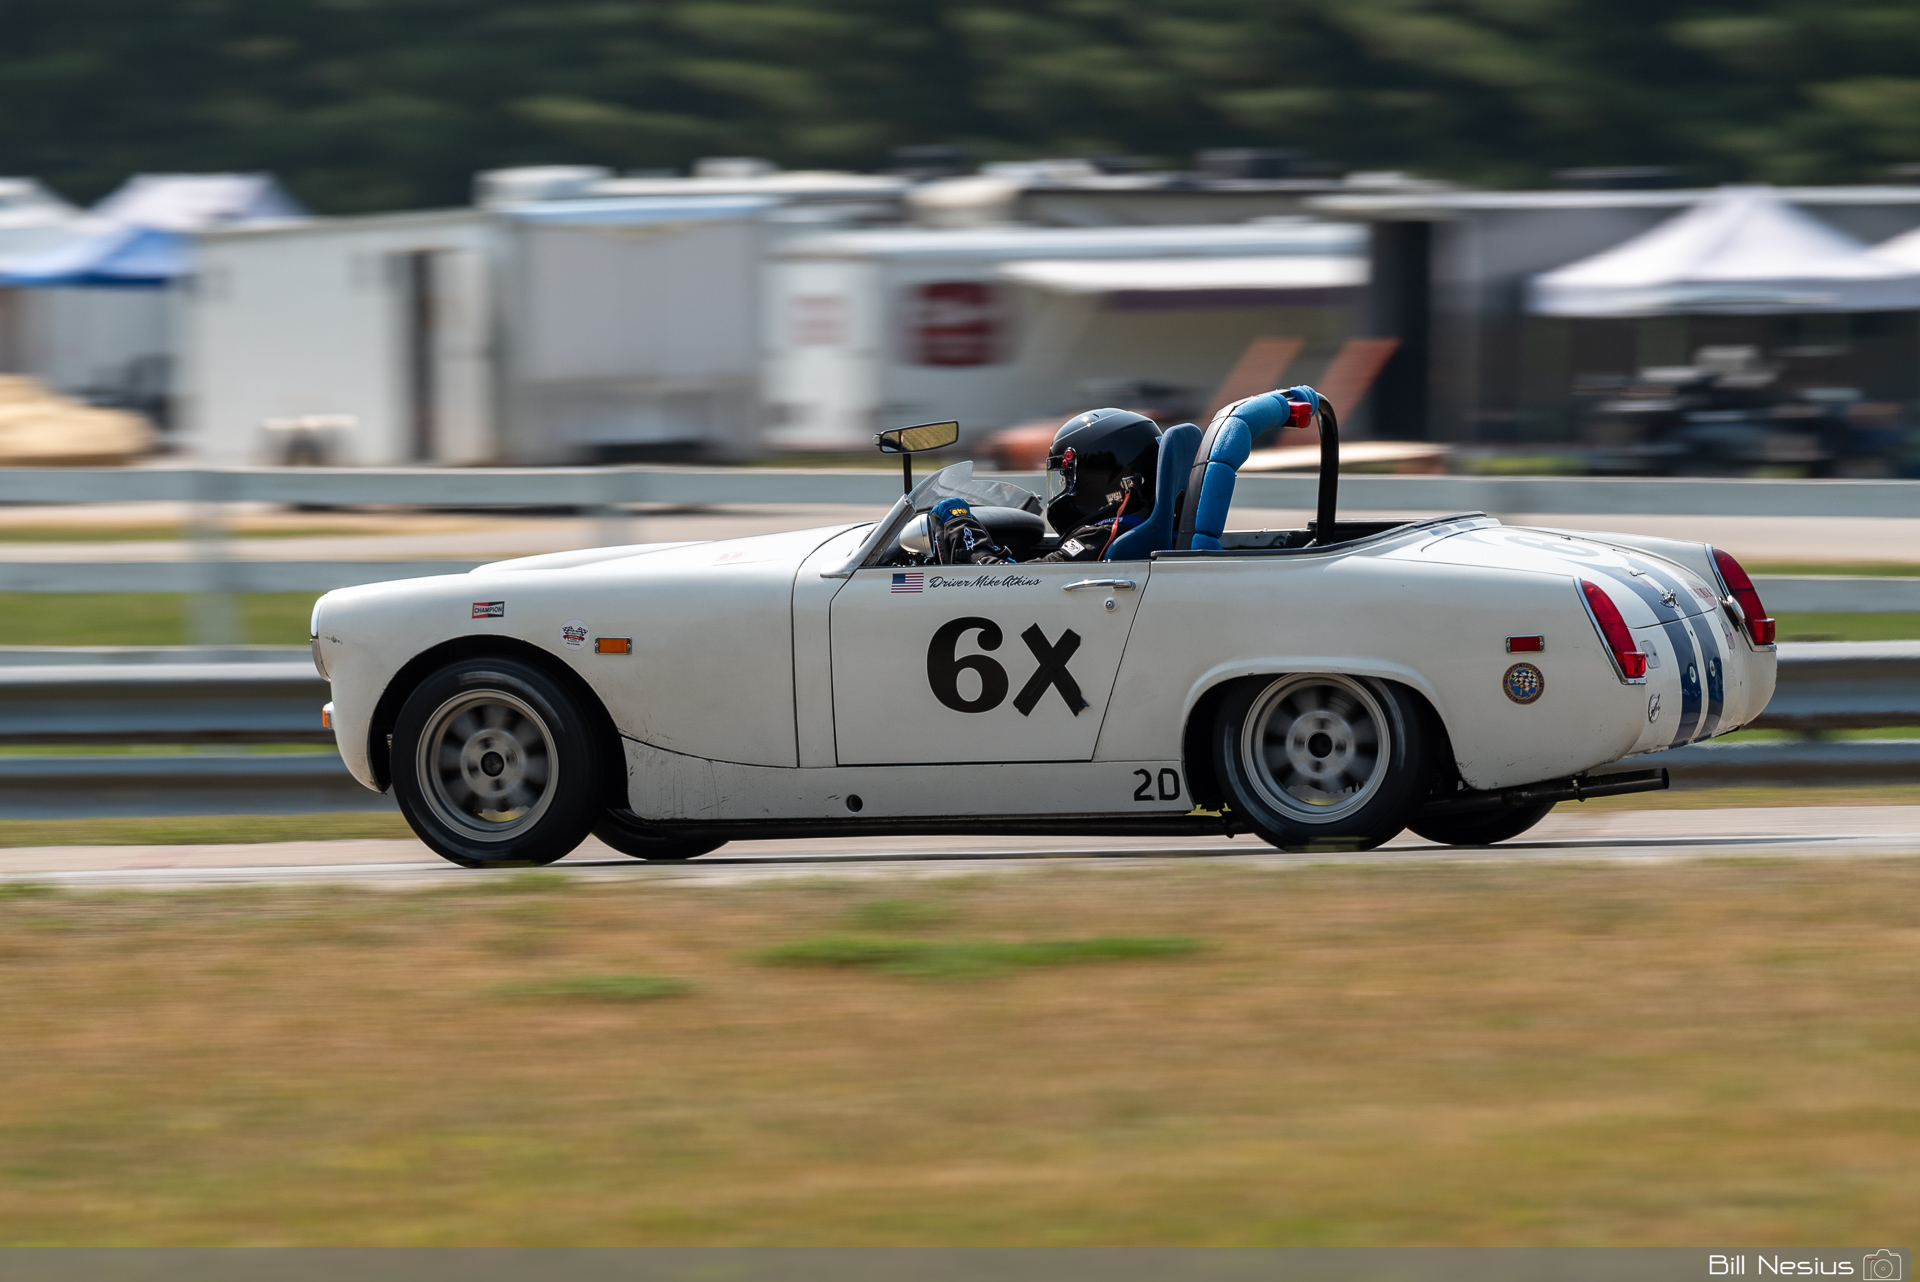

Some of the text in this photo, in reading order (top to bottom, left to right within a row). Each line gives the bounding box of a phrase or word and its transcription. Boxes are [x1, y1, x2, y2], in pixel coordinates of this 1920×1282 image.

[929, 575, 1041, 588] Driver Mike Atkins
[474, 606, 503, 614] CHAMPION
[926, 616, 1090, 717] 6X
[1133, 767, 1181, 801] 2D
